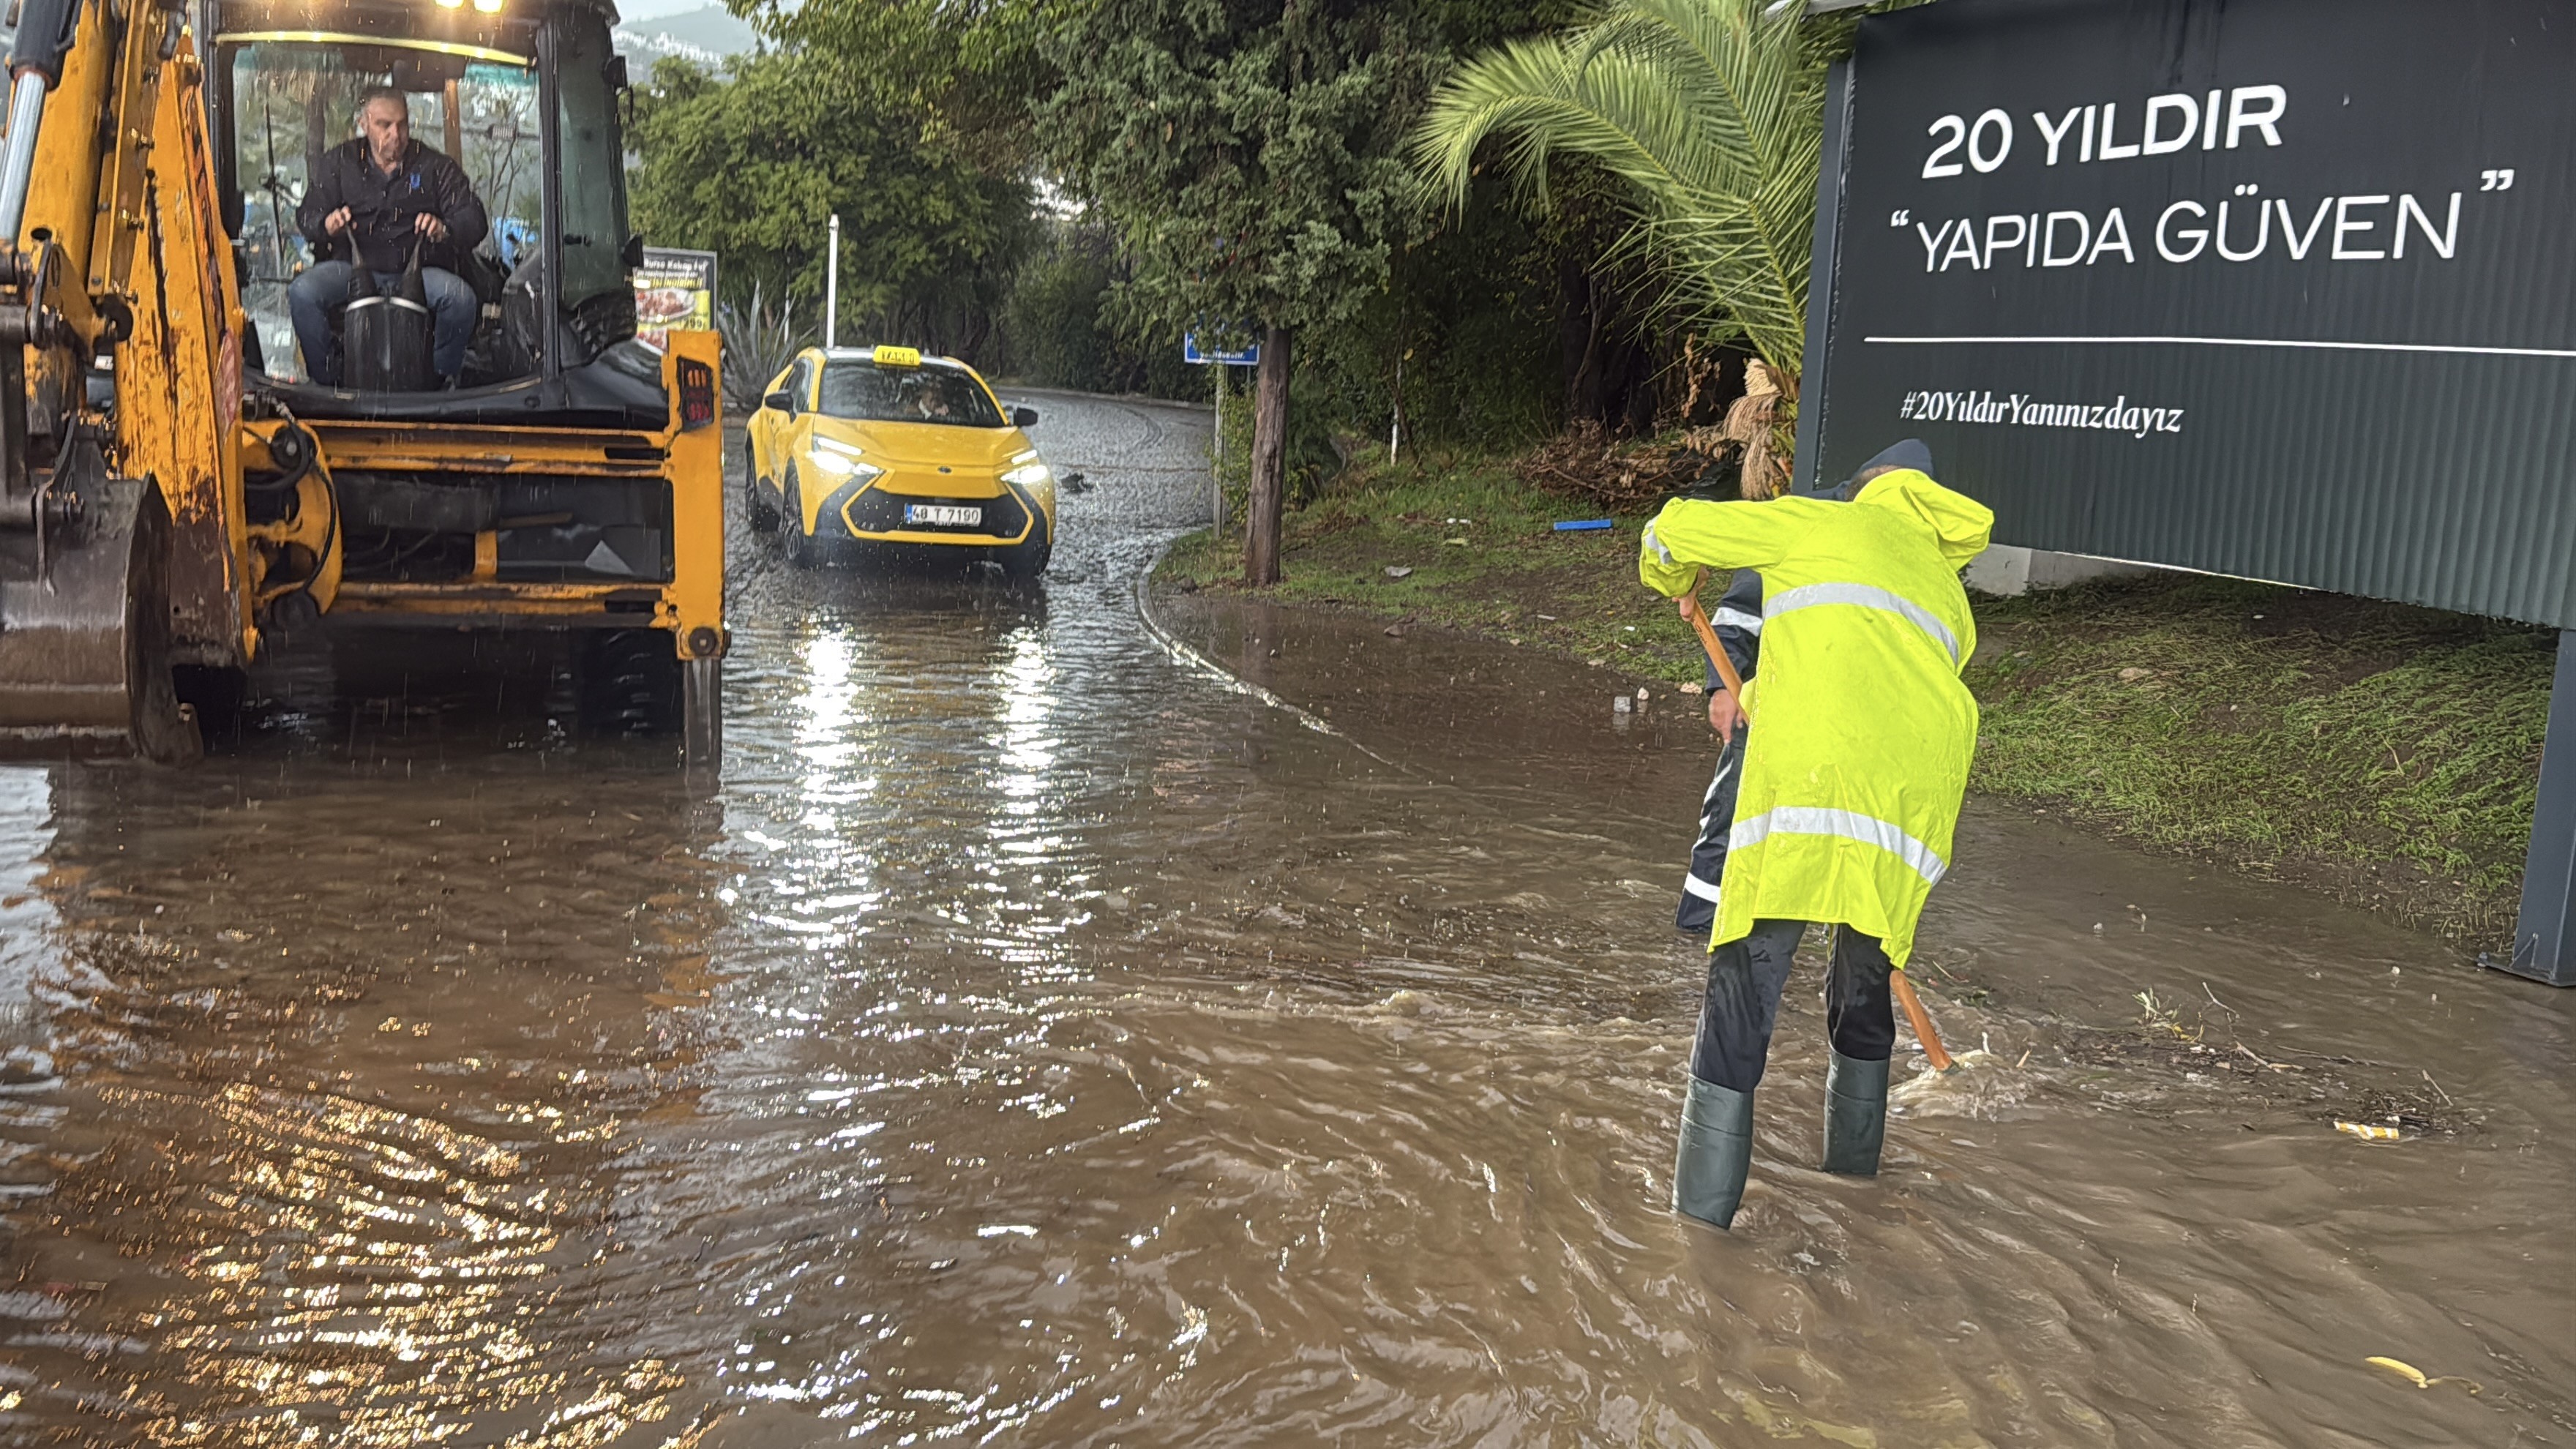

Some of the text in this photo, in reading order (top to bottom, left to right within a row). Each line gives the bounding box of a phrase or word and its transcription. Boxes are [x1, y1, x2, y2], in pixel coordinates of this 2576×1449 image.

[1922, 85, 2286, 178] 20 YILDIR
[1901, 391, 2184, 438] #20YıldırYanınızdayız
[913, 506, 928, 519] 48
[935, 508, 942, 522] T
